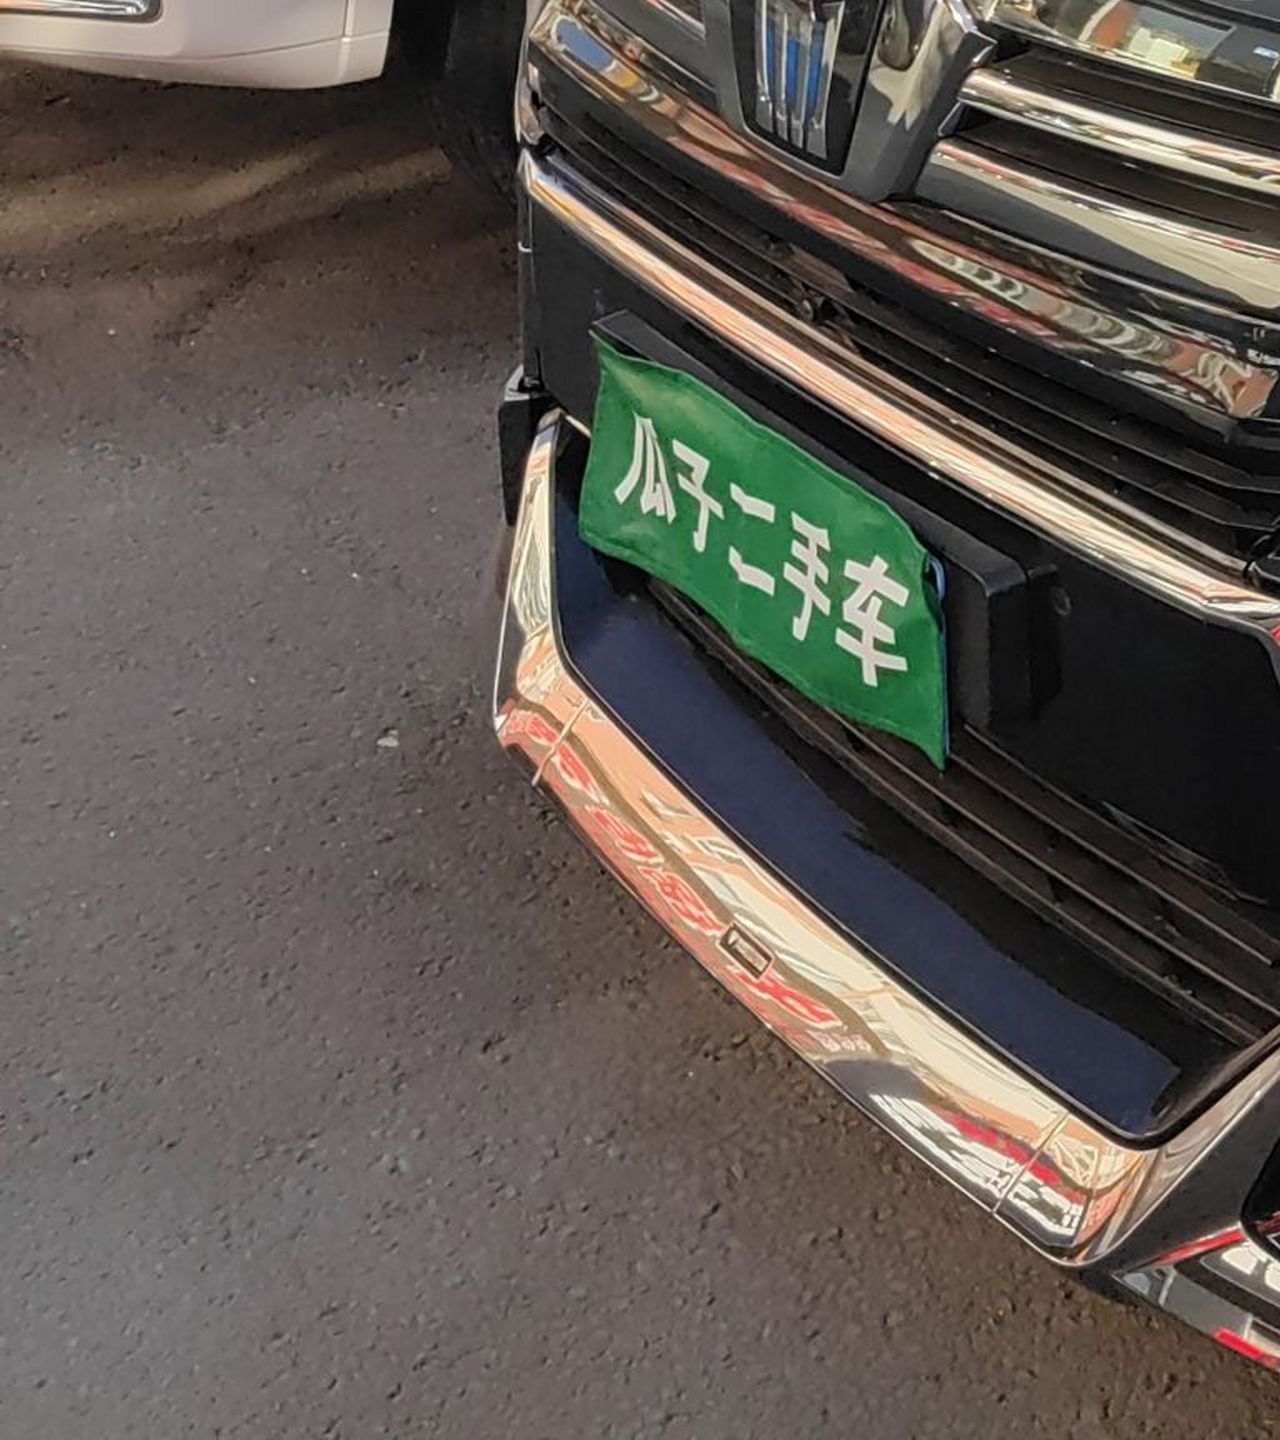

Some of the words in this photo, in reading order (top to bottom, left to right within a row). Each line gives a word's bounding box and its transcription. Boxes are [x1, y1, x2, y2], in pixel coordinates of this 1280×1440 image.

[614, 411, 909, 687] 瓜子二手车
